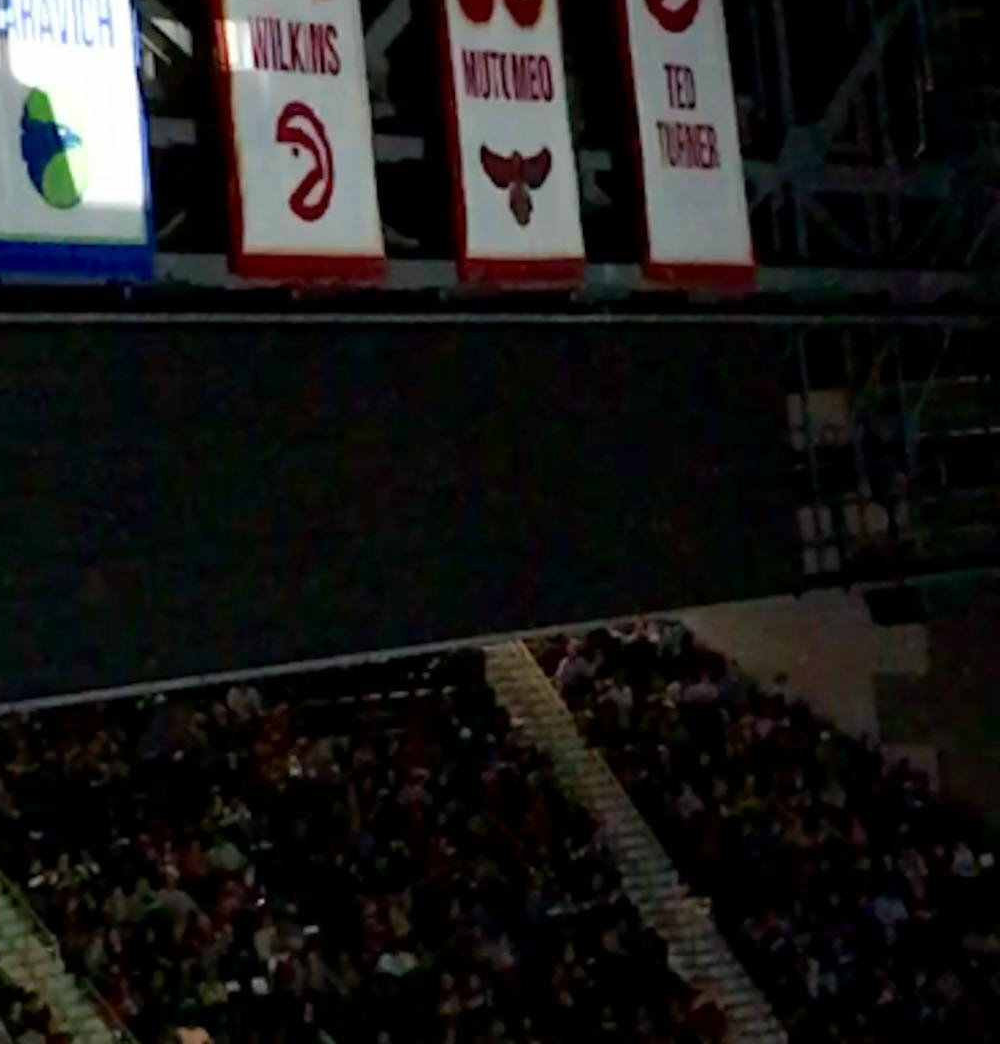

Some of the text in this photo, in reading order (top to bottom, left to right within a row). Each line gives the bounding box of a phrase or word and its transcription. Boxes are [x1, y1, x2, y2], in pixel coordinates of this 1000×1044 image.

[251, 16, 341, 77] WILKINS
[663, 63, 697, 110] TED
[655, 120, 721, 170] TURNER
